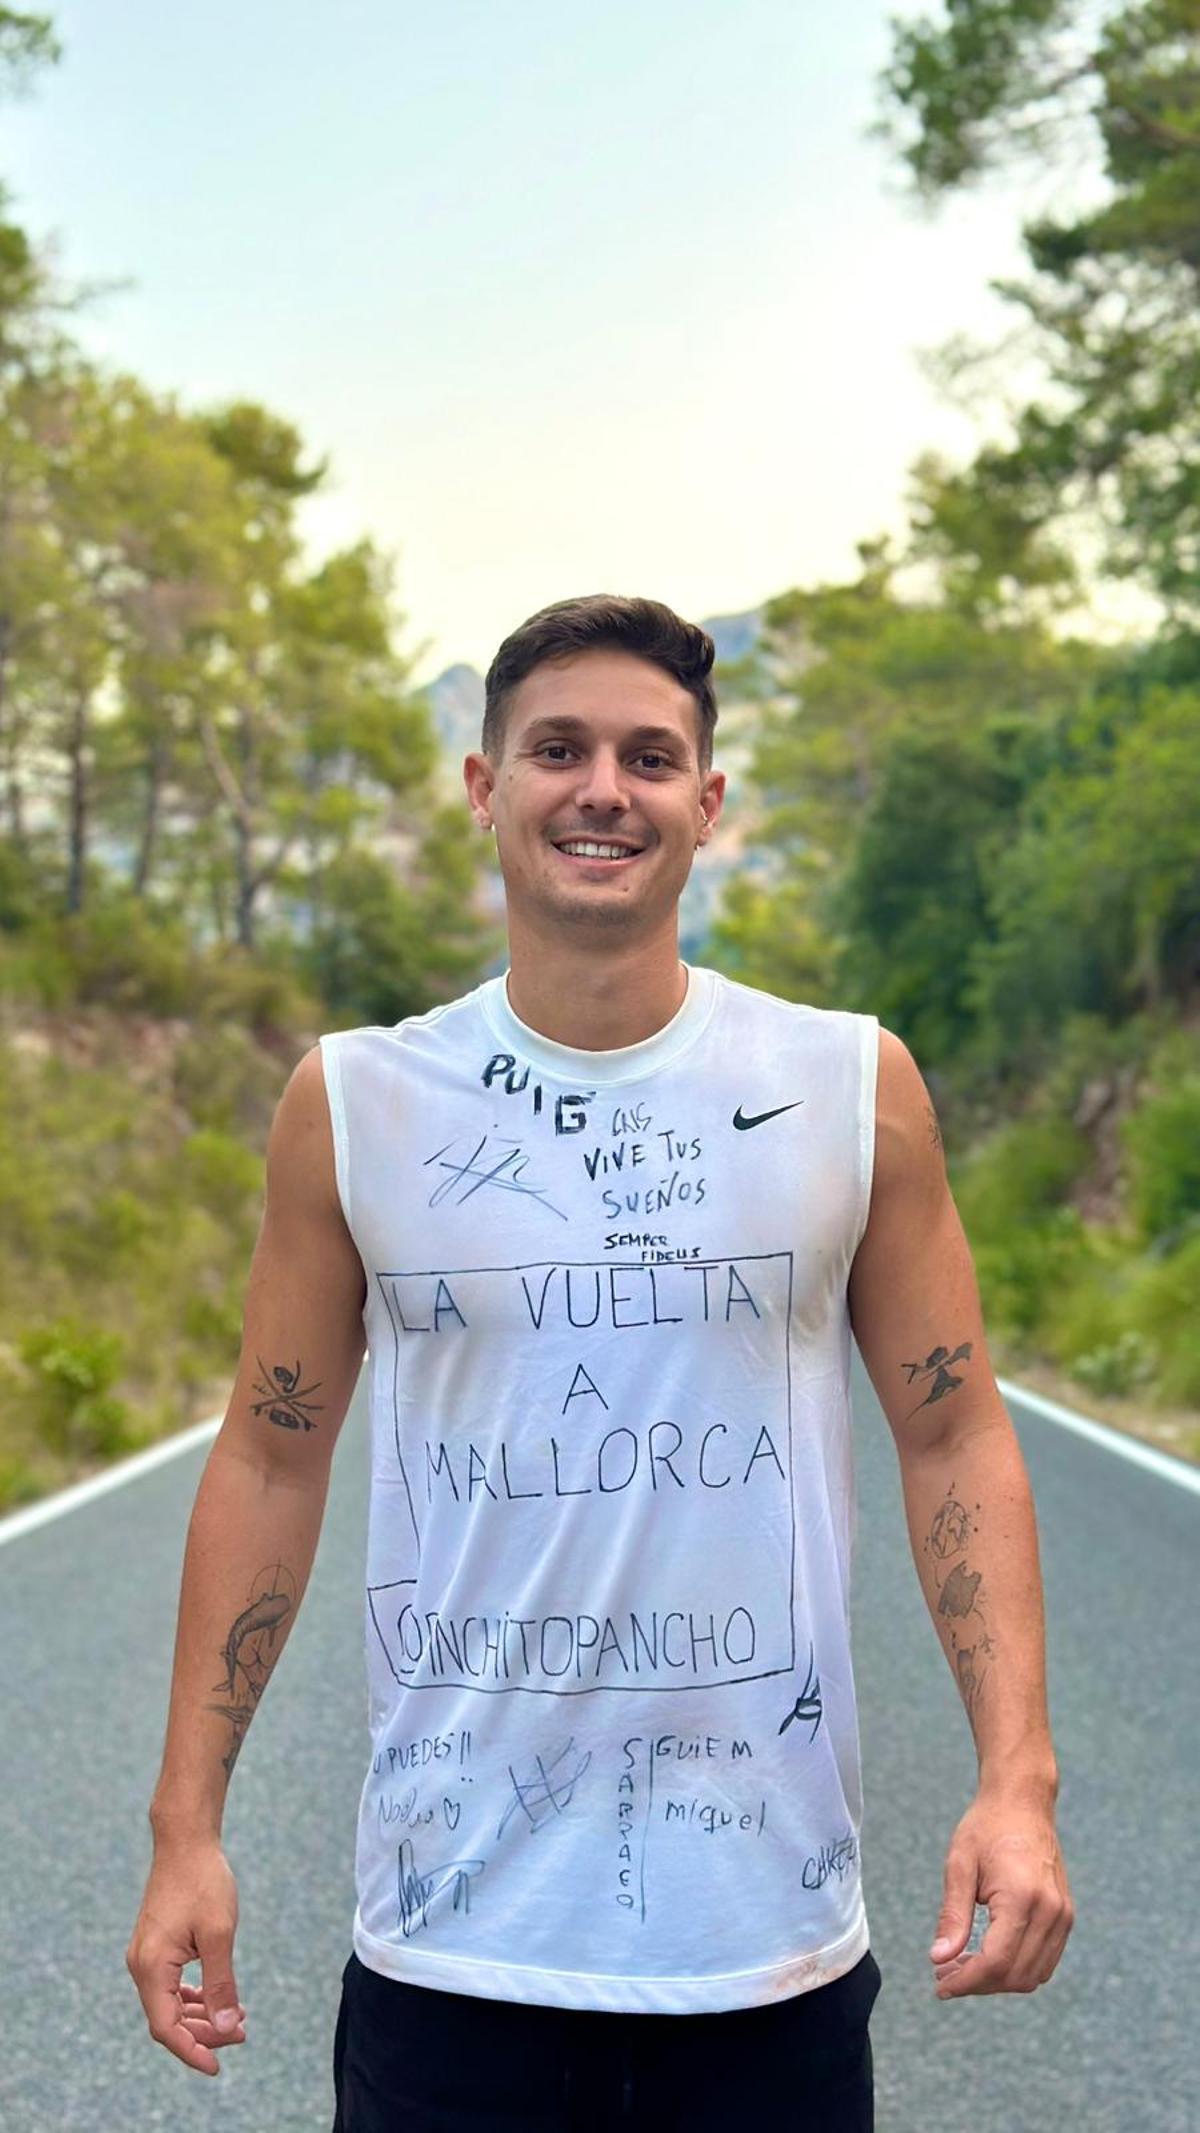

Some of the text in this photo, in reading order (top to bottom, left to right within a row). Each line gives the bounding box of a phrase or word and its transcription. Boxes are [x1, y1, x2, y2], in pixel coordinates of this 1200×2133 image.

[481, 1053, 597, 1136] PUIG
[583, 1141, 646, 1181] VIVE
[602, 1171, 706, 1219] SUEÑOS
[603, 1232, 668, 1250] SEMPER
[391, 1264, 761, 1332] LA VUELTA
[562, 1362, 609, 1415] A
[424, 1420, 786, 1504] MALLORCA
